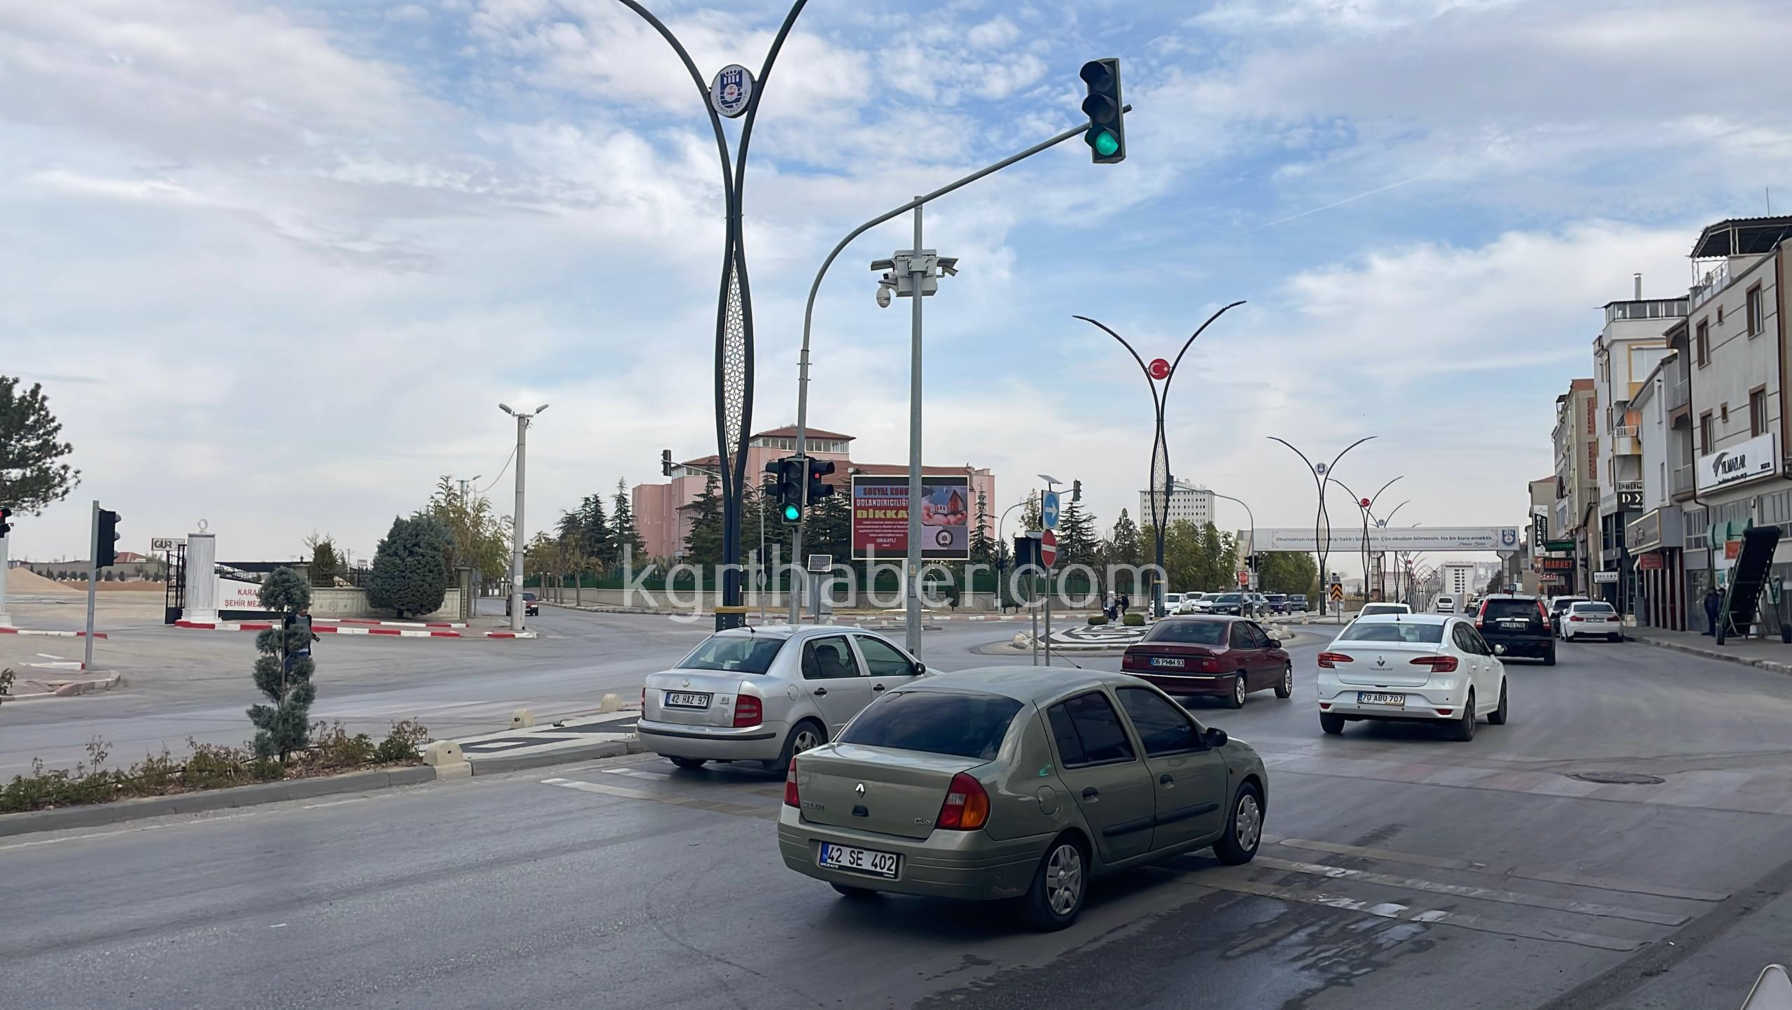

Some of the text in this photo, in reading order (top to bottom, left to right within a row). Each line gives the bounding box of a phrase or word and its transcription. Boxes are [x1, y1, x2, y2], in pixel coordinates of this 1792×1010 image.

[856, 508, 909, 519] DİKKA
[237, 588, 258, 597] KARA
[827, 846, 895, 873] 42 SE 402
